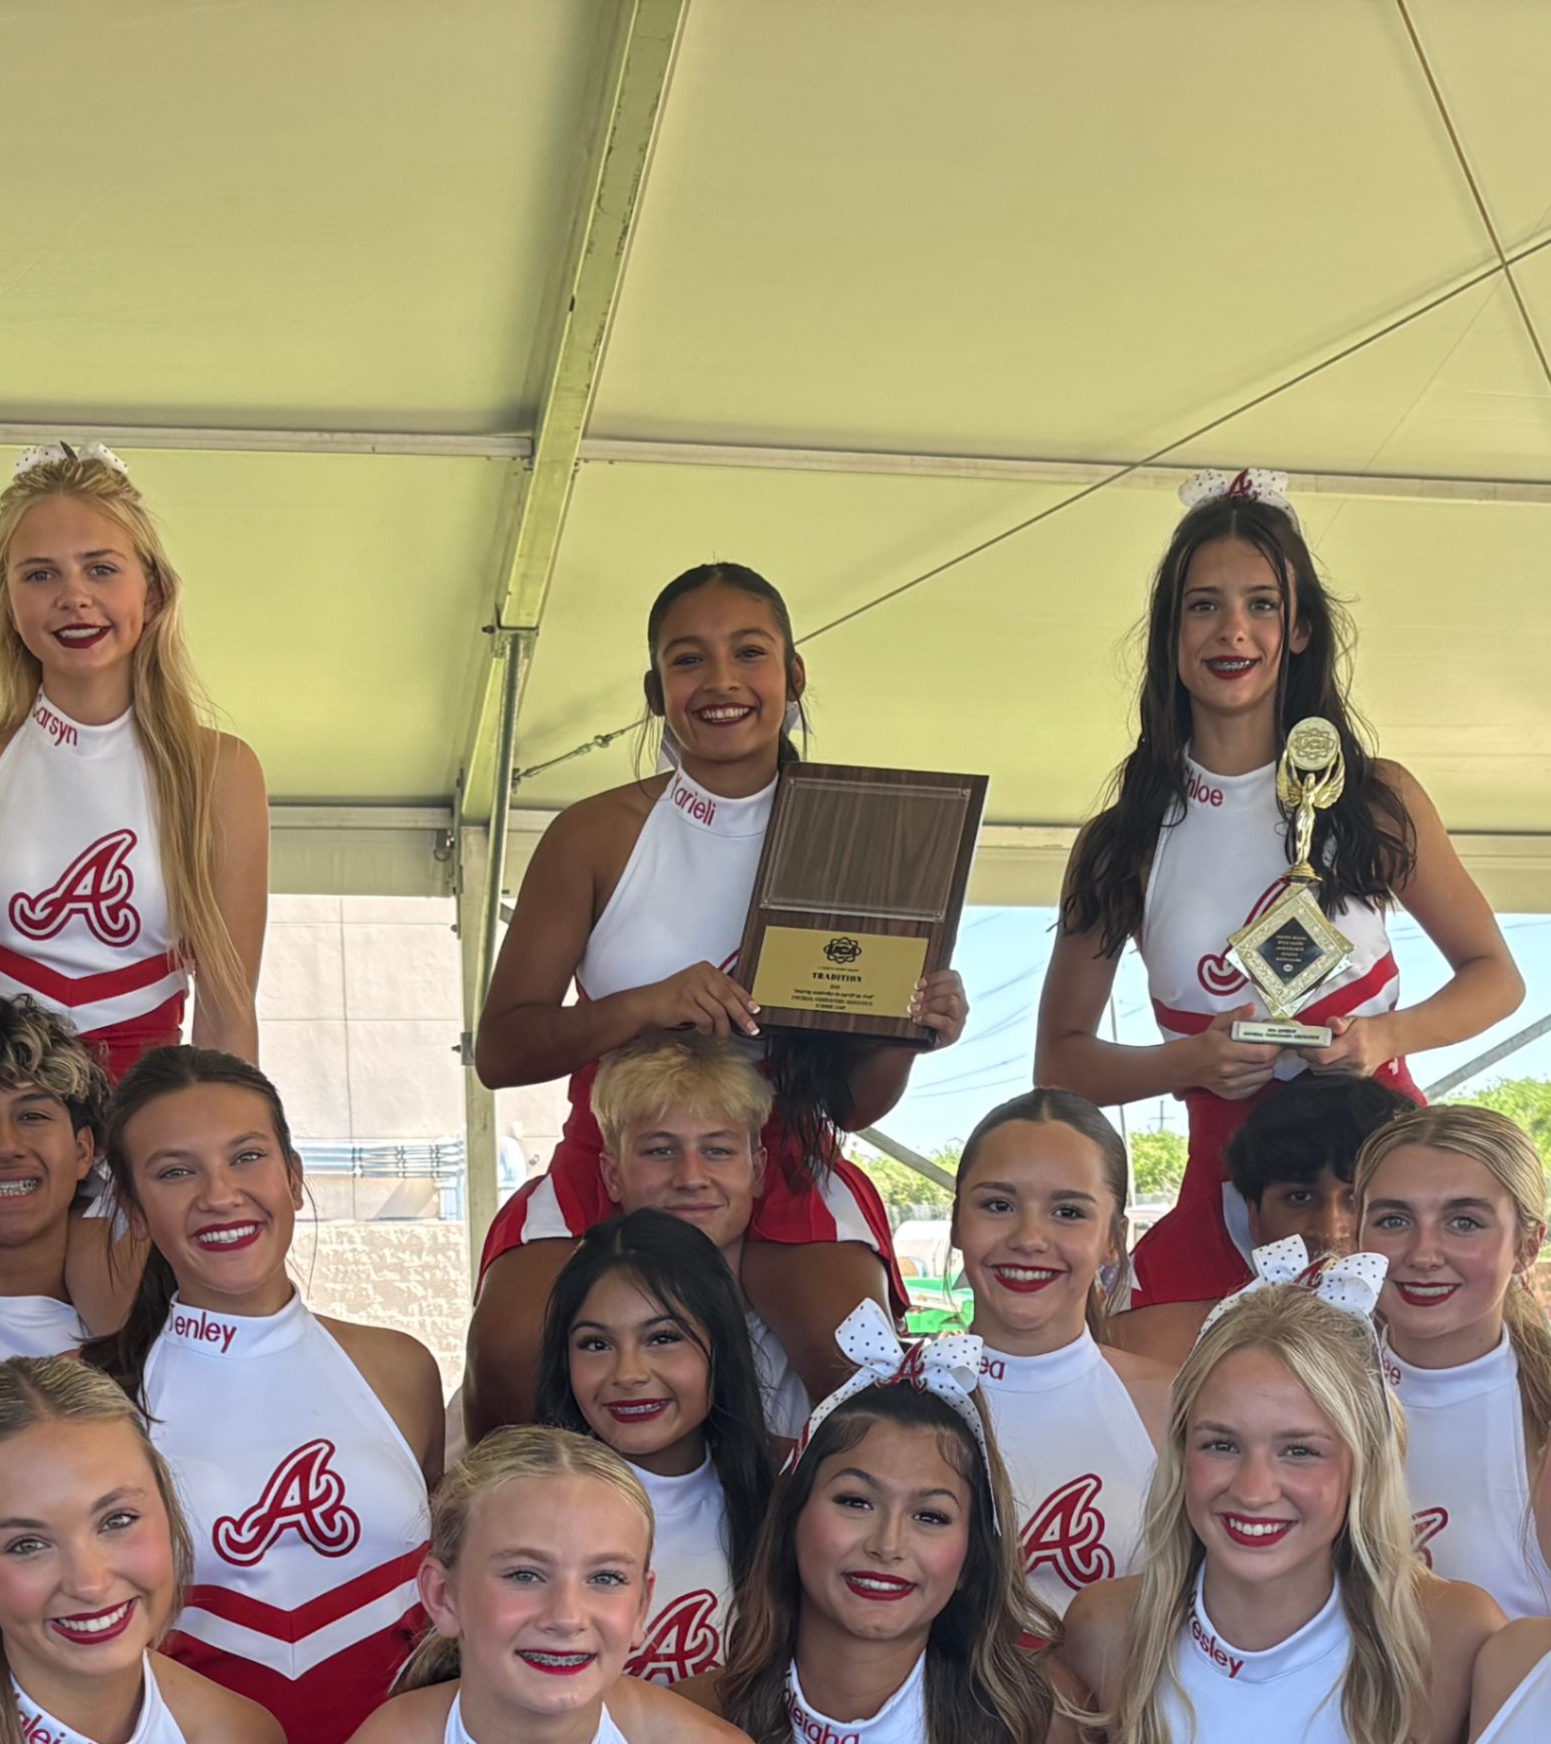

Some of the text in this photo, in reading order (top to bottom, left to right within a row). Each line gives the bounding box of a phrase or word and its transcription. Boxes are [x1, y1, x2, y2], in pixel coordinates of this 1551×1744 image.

[1185, 766, 1223, 807] hloe
[8, 828, 141, 948] A
[212, 1438, 361, 1567] A
[1017, 1473, 1116, 1591] A
[622, 1589, 722, 1684] A
[1191, 1620, 1245, 1678] esley
